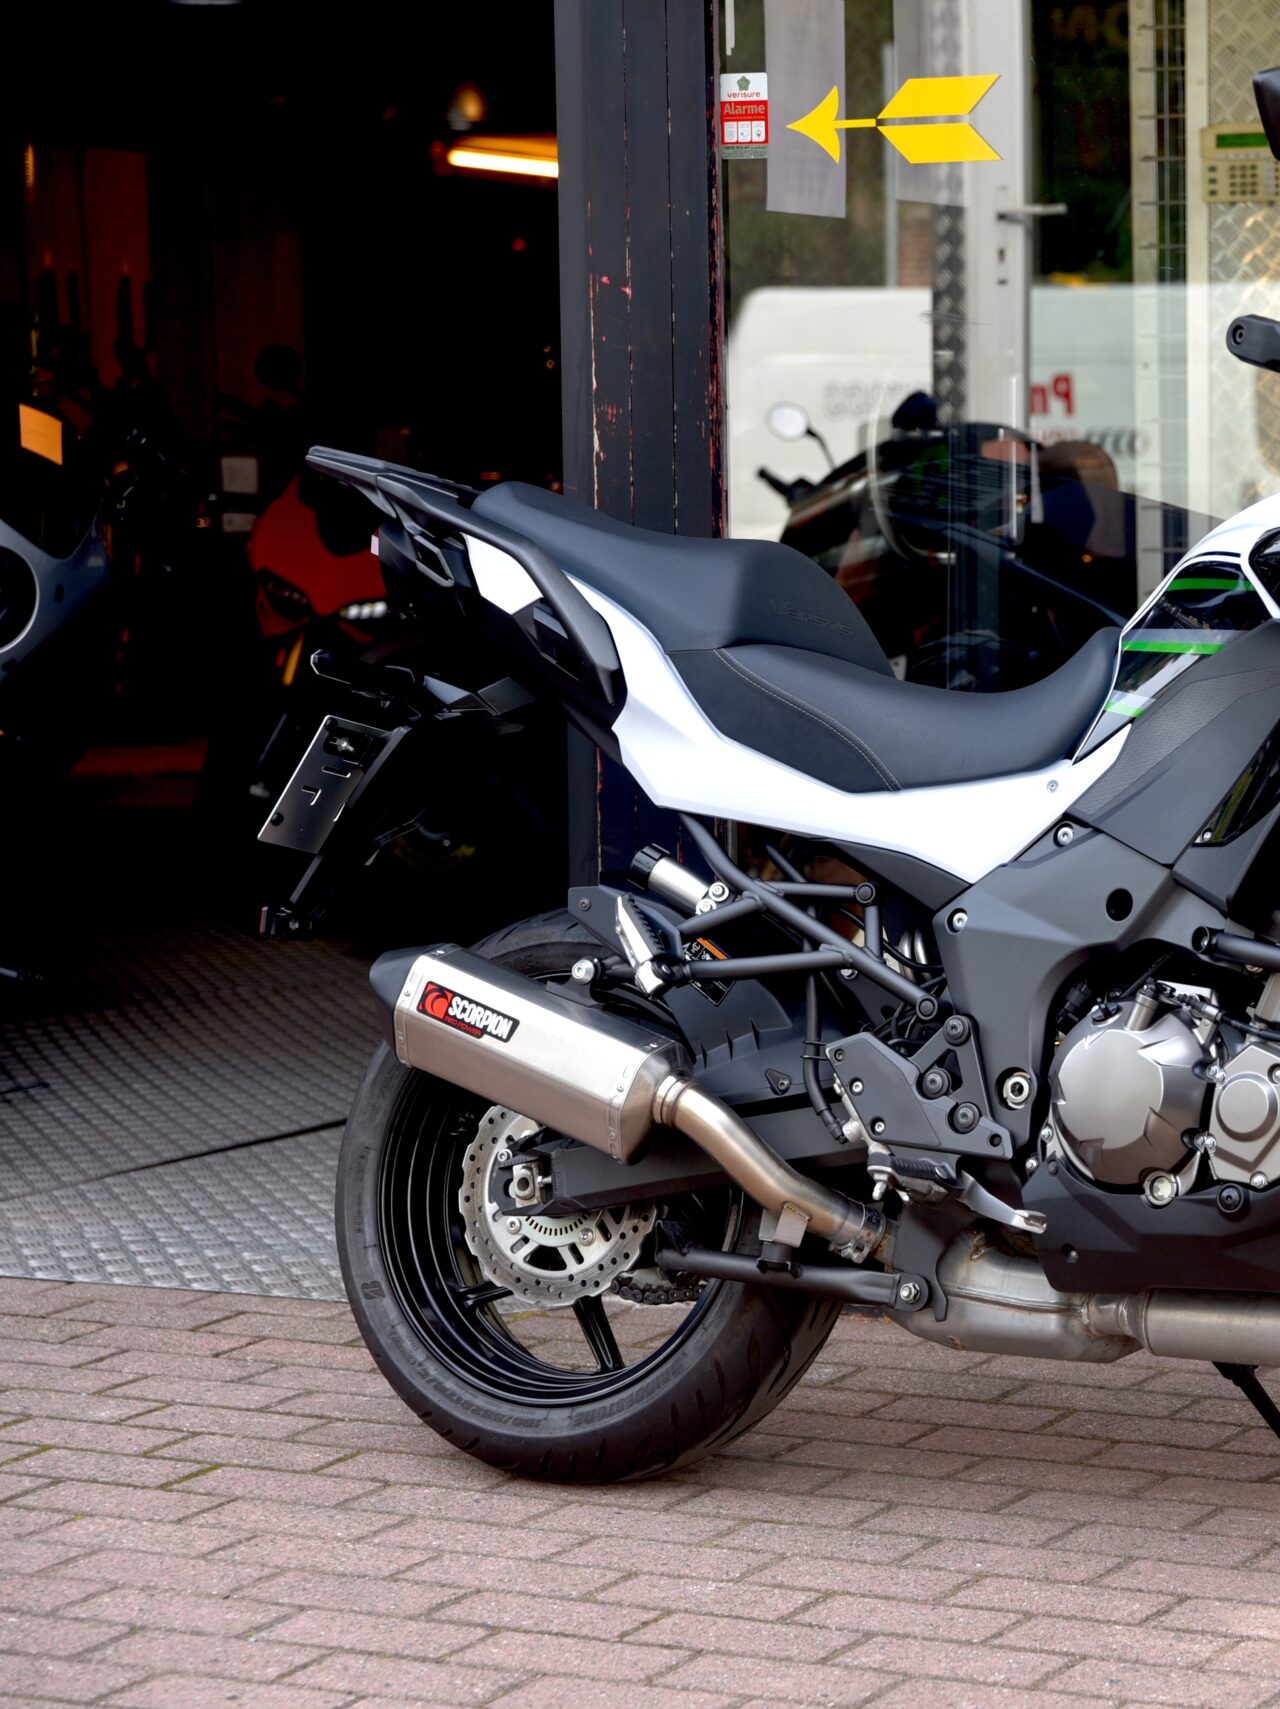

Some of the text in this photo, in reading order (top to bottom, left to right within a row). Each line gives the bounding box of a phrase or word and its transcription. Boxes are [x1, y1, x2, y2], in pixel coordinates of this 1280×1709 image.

[727, 91, 761, 99] verisure
[724, 102, 765, 115] Alarme
[448, 996, 513, 1039] SCORPION
[445, 1016, 482, 1037] RED POWER
